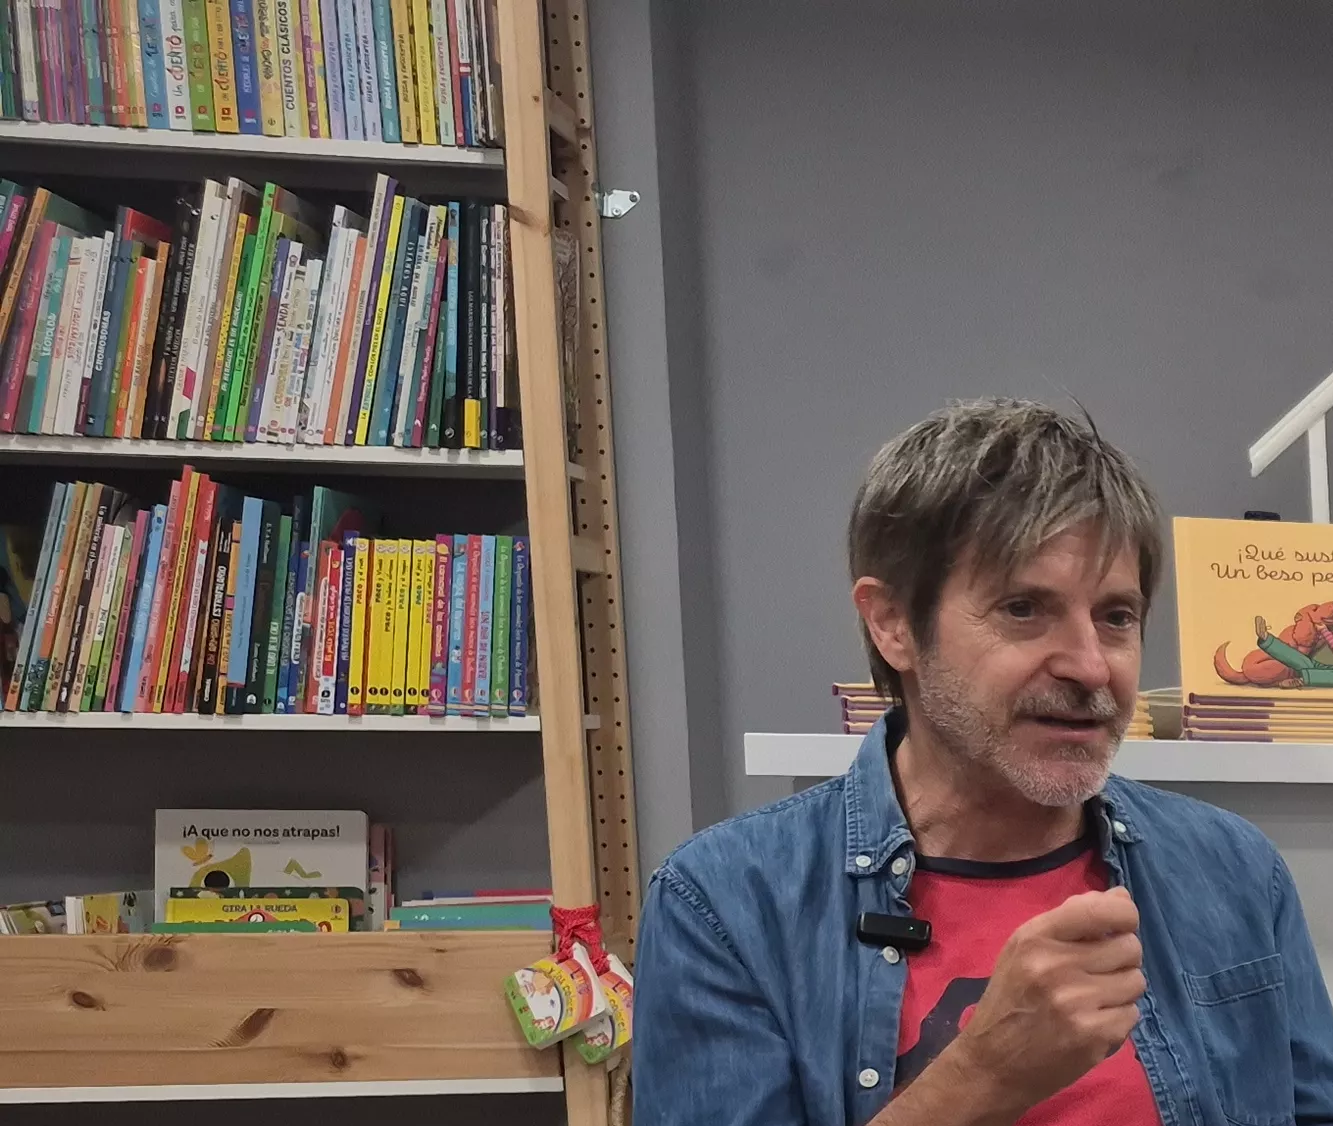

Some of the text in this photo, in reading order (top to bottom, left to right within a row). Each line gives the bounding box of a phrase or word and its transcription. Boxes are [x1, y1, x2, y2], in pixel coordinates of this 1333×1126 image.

[164, 34, 184, 81] CUENTO
[276, 0, 294, 110] CUENTOS CLÁSICOS
[94, 310, 111, 371] CROMOSOMAS
[91, 515, 105, 542] misterio
[1238, 544, 1286, 563] ¡Qué
[437, 564, 446, 597] carnaval
[1210, 562, 1250, 579] Un
[1256, 564, 1304, 581] beso
[211, 565, 226, 616] ESTRAFALARIO
[355, 583, 363, 604] PACO
[374, 582, 382, 602] PACO
[438, 599, 445, 608] de
[383, 611, 391, 632] PACO
[436, 611, 444, 622] los
[207, 618, 220, 651] ARMARIO
[434, 624, 444, 657] animales
[183, 825, 340, 842] ¡A que no nos atrapas!
[222, 905, 247, 913] GIRA
[264, 905, 297, 913] RUEDA
